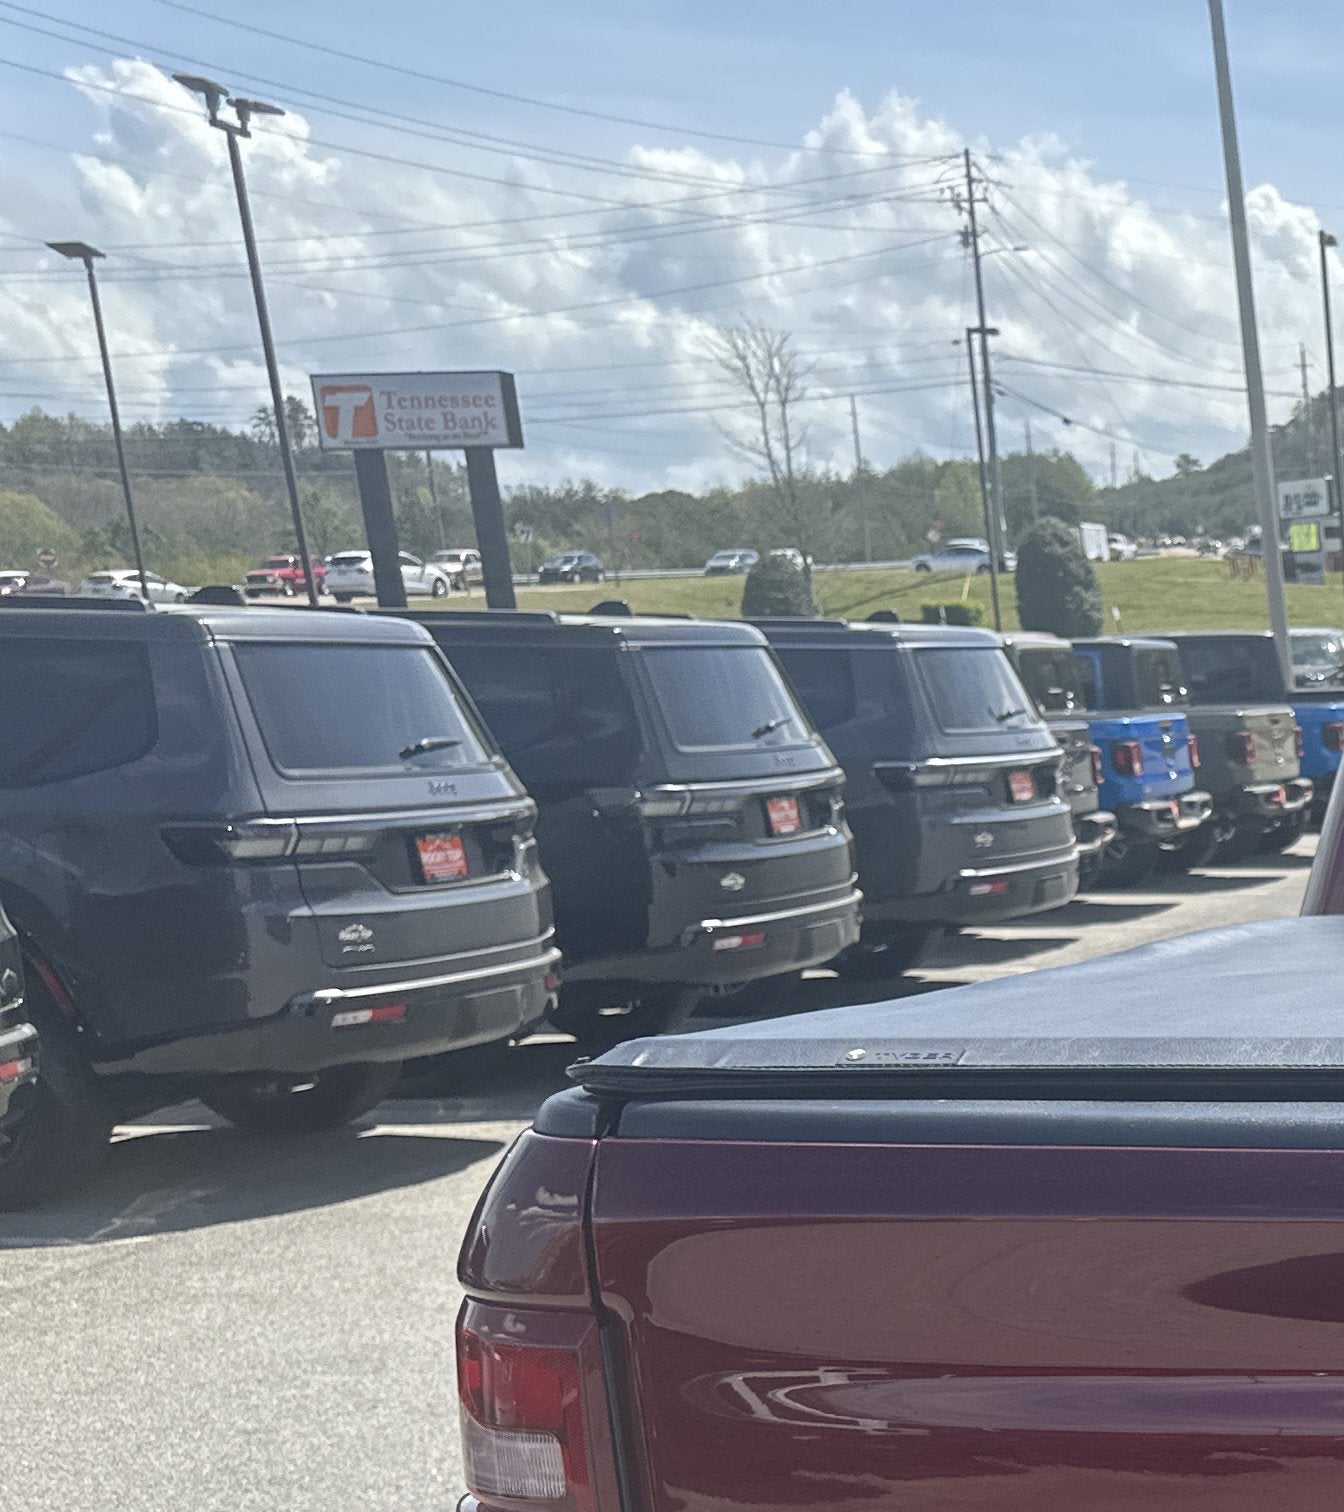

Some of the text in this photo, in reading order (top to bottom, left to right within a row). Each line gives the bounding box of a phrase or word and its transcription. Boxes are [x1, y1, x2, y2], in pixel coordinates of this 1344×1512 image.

[380, 390, 497, 410] Tennessee
[384, 410, 497, 433] State Bank
